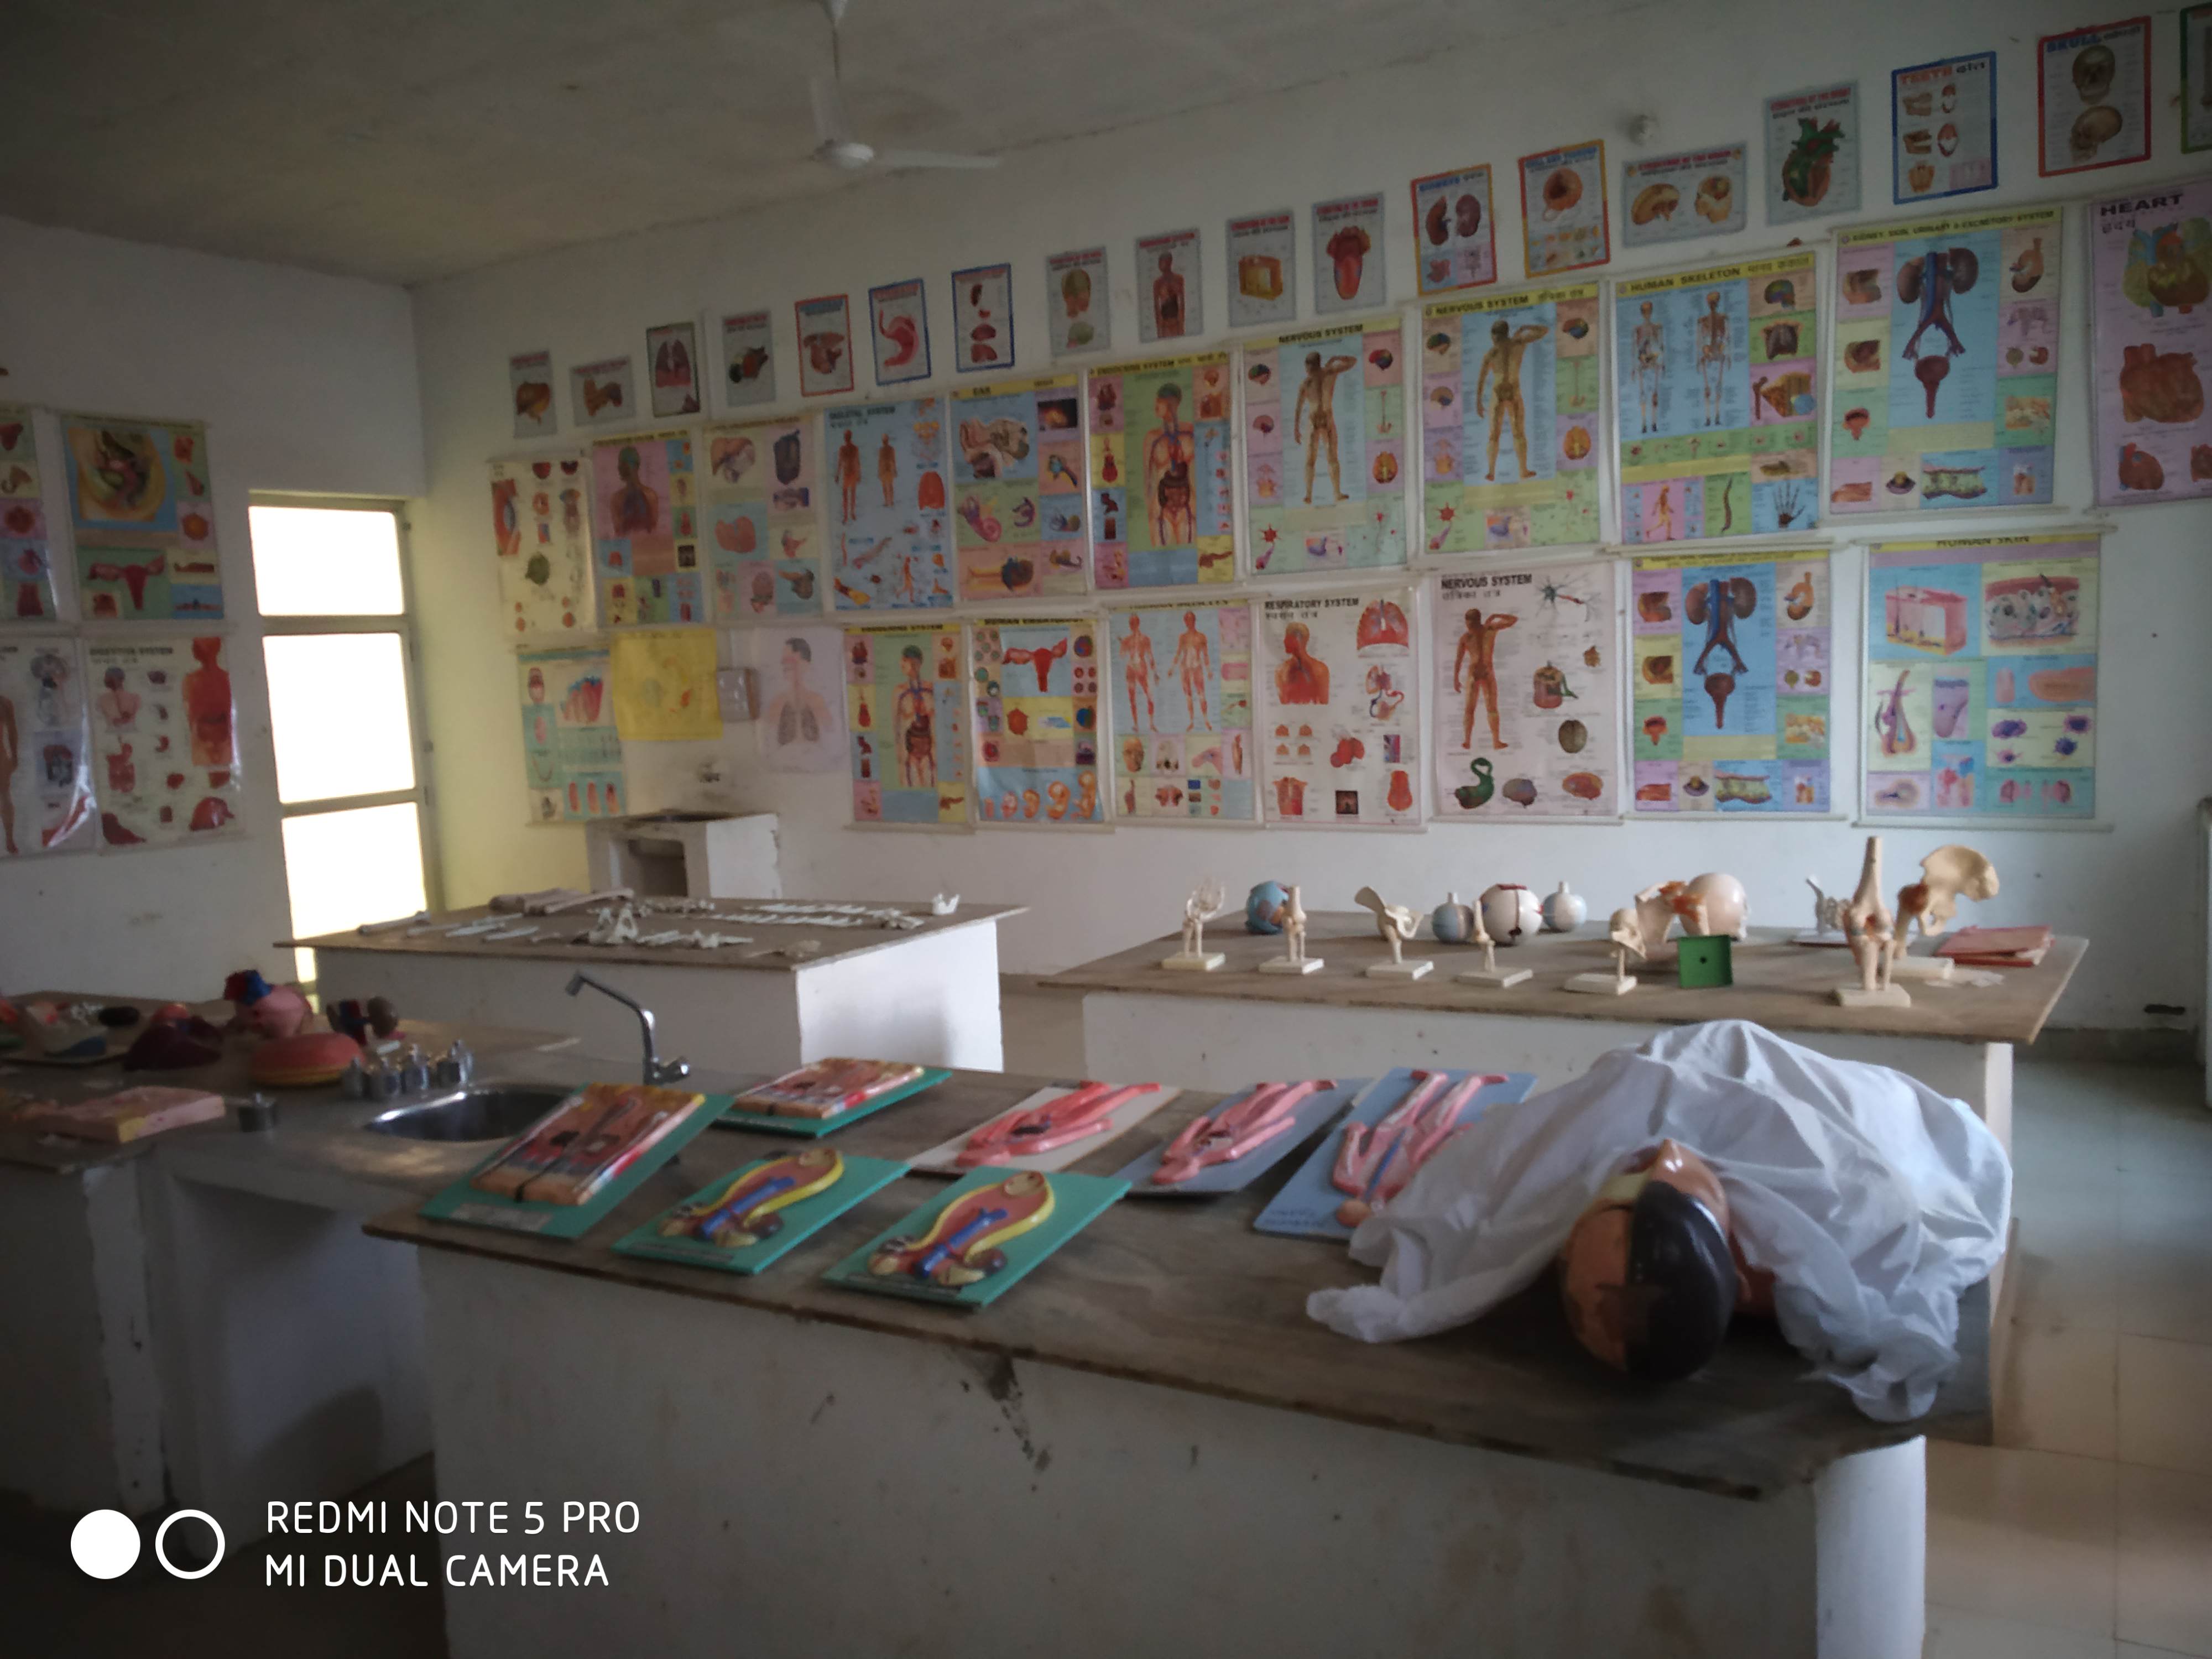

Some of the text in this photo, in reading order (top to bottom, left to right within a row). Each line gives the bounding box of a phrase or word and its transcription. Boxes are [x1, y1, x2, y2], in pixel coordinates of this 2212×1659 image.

[2101, 194, 2183, 216] HEART
[1631, 268, 1740, 291] HUMAN SKELETON
[1436, 301, 1483, 314] NERVOUS
[1487, 295, 1528, 308] SYSTEM
[1279, 324, 1363, 343] NERVOUS SYSTEM
[1143, 360, 1175, 370] SYSTEM
[1442, 573, 1532, 589] NERVOUS SYSTEM
[1265, 598, 1359, 609] RESPIRATORY SYSTEM
